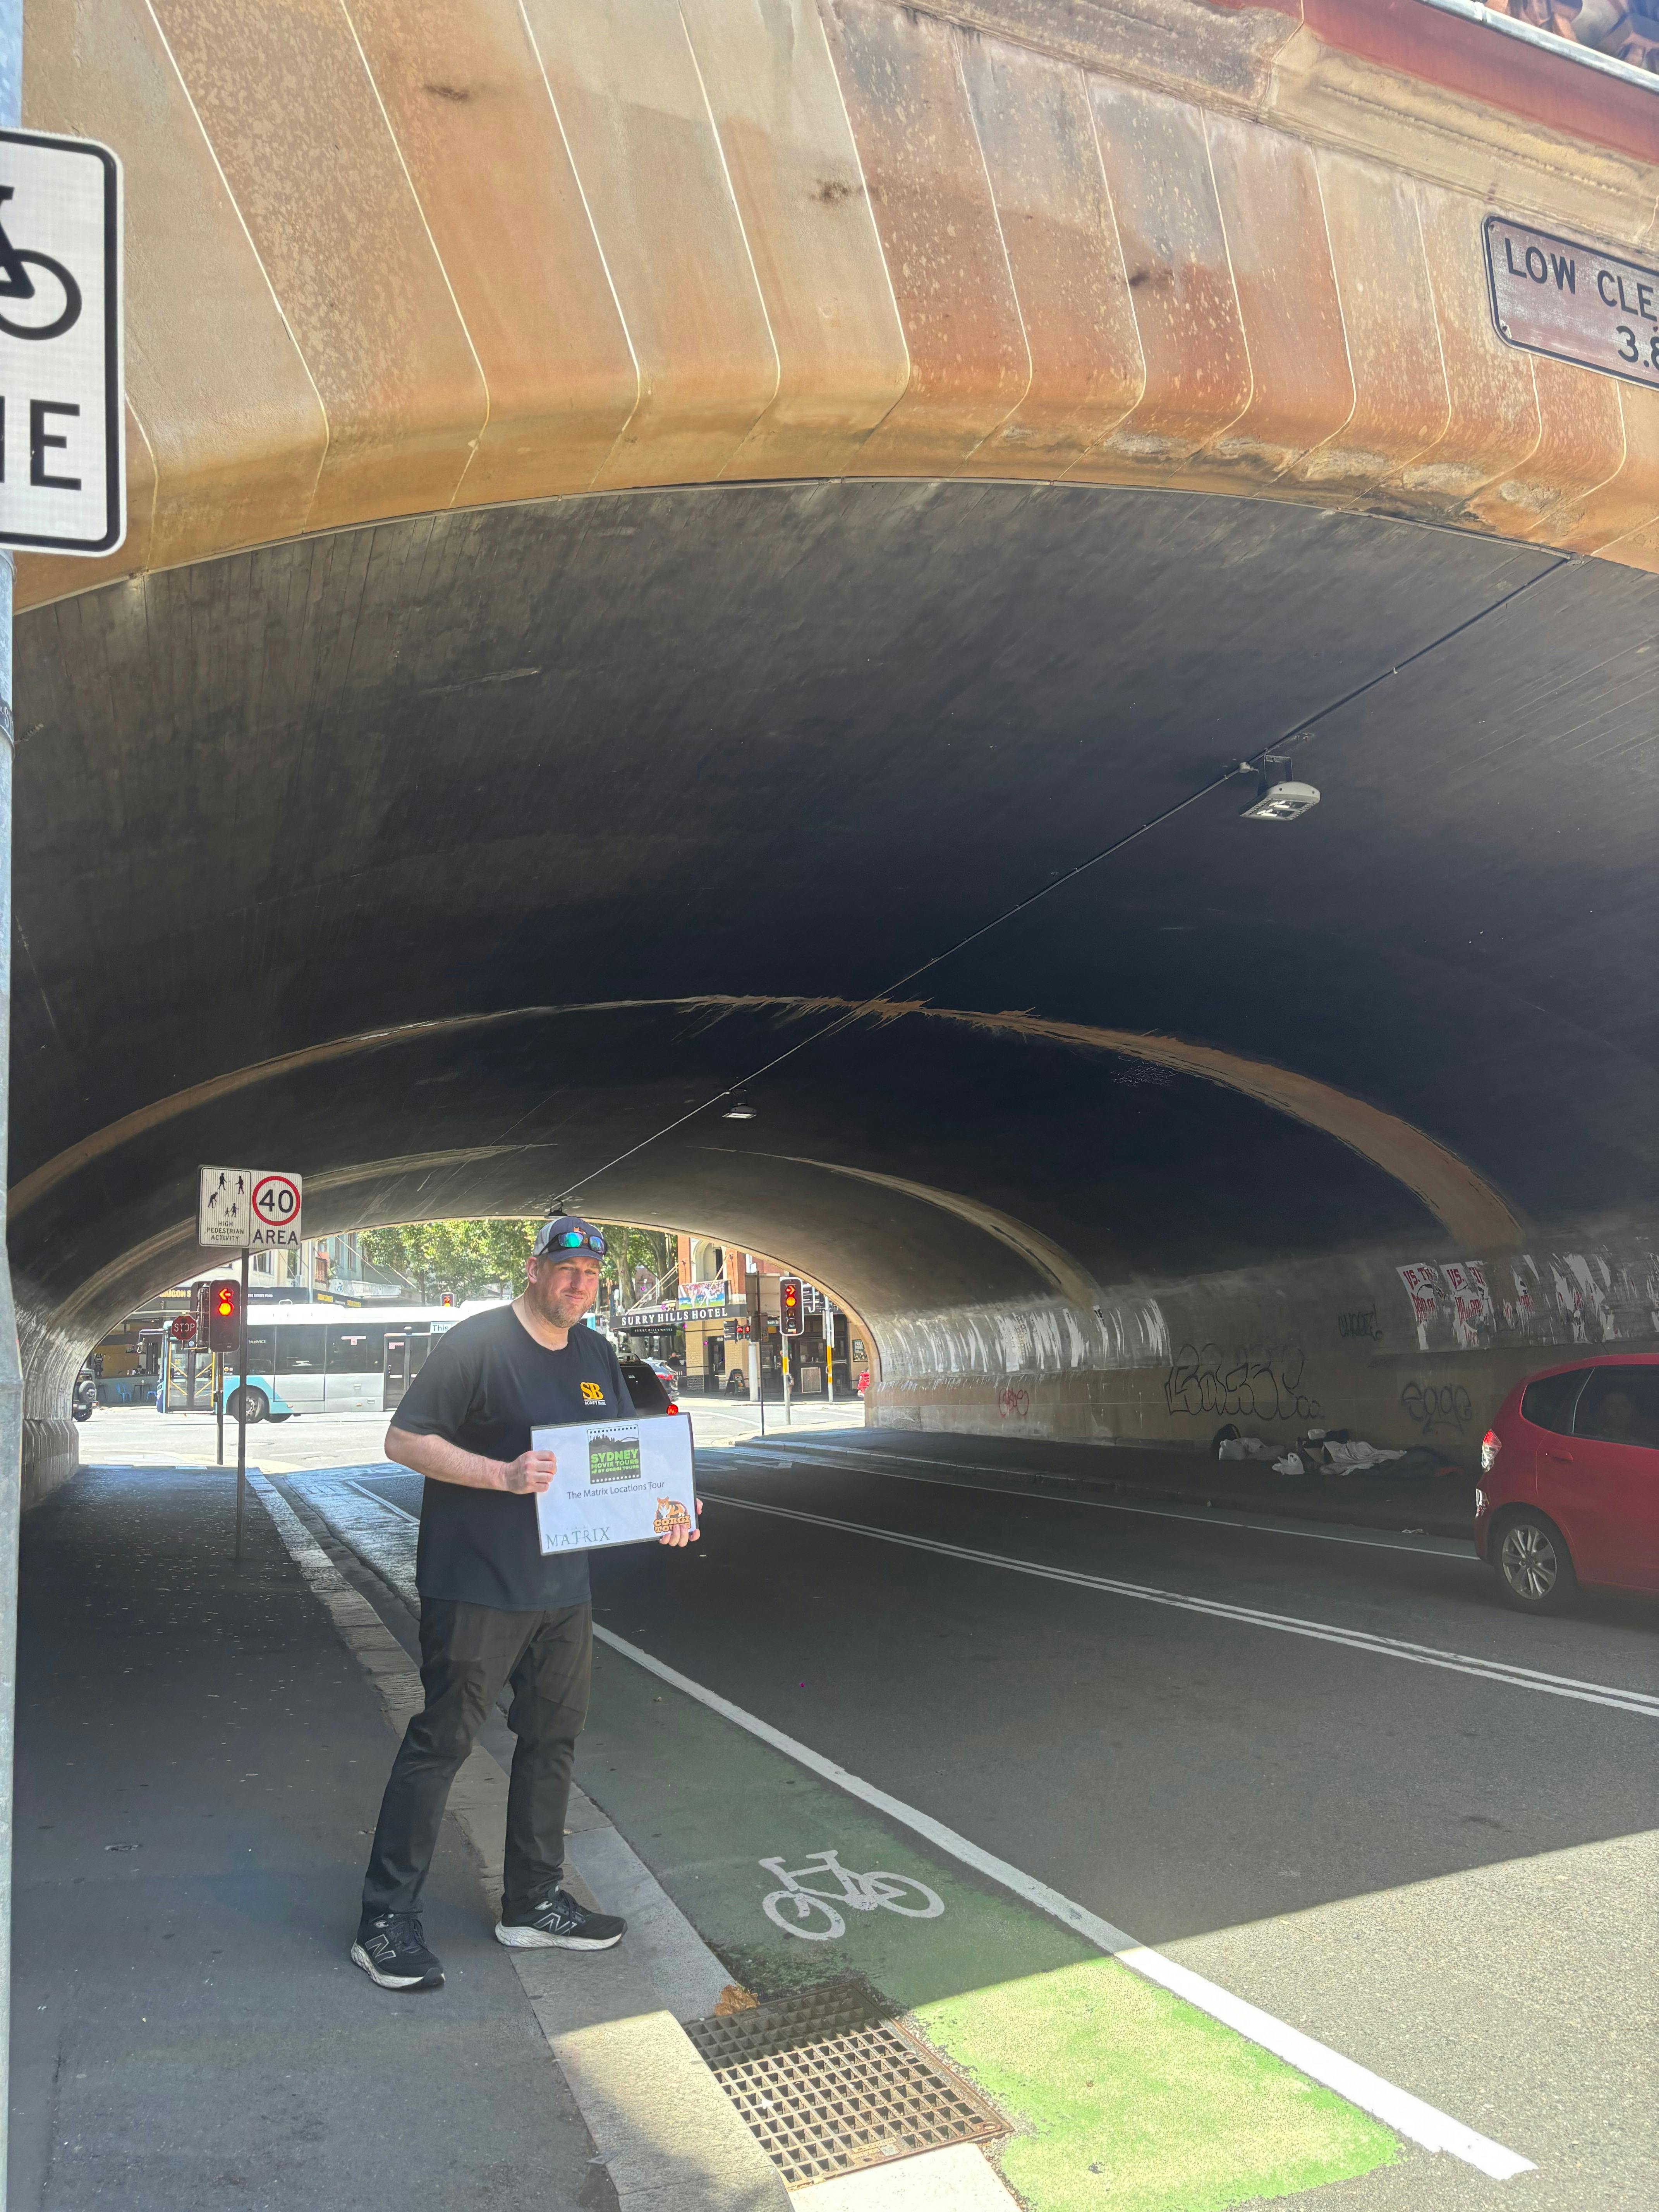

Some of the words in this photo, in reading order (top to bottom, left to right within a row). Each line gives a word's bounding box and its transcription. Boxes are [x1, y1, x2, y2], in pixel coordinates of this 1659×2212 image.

[1505, 237, 1576, 295] LOW
[1597, 270, 1657, 322] CLE
[0, 395, 82, 491] E
[259, 1189, 294, 1213] 40
[252, 1229, 298, 1245] AREA
[622, 1314, 654, 1326] SURRY
[658, 1311, 689, 1322] HILLS
[692, 1308, 728, 1319] HOTEL
[174, 1322, 195, 1332] STOP
[580, 1382, 603, 1399] SB
[591, 1449, 638, 1463] SYDNEY
[567, 1491, 582, 1499] The
[584, 1489, 608, 1498] Matrix
[610, 1483, 647, 1494] Locations
[647, 1481, 665, 1489] Tour
[654, 1515, 690, 1527] CORGI
[546, 1527, 610, 1549] MATRIX
